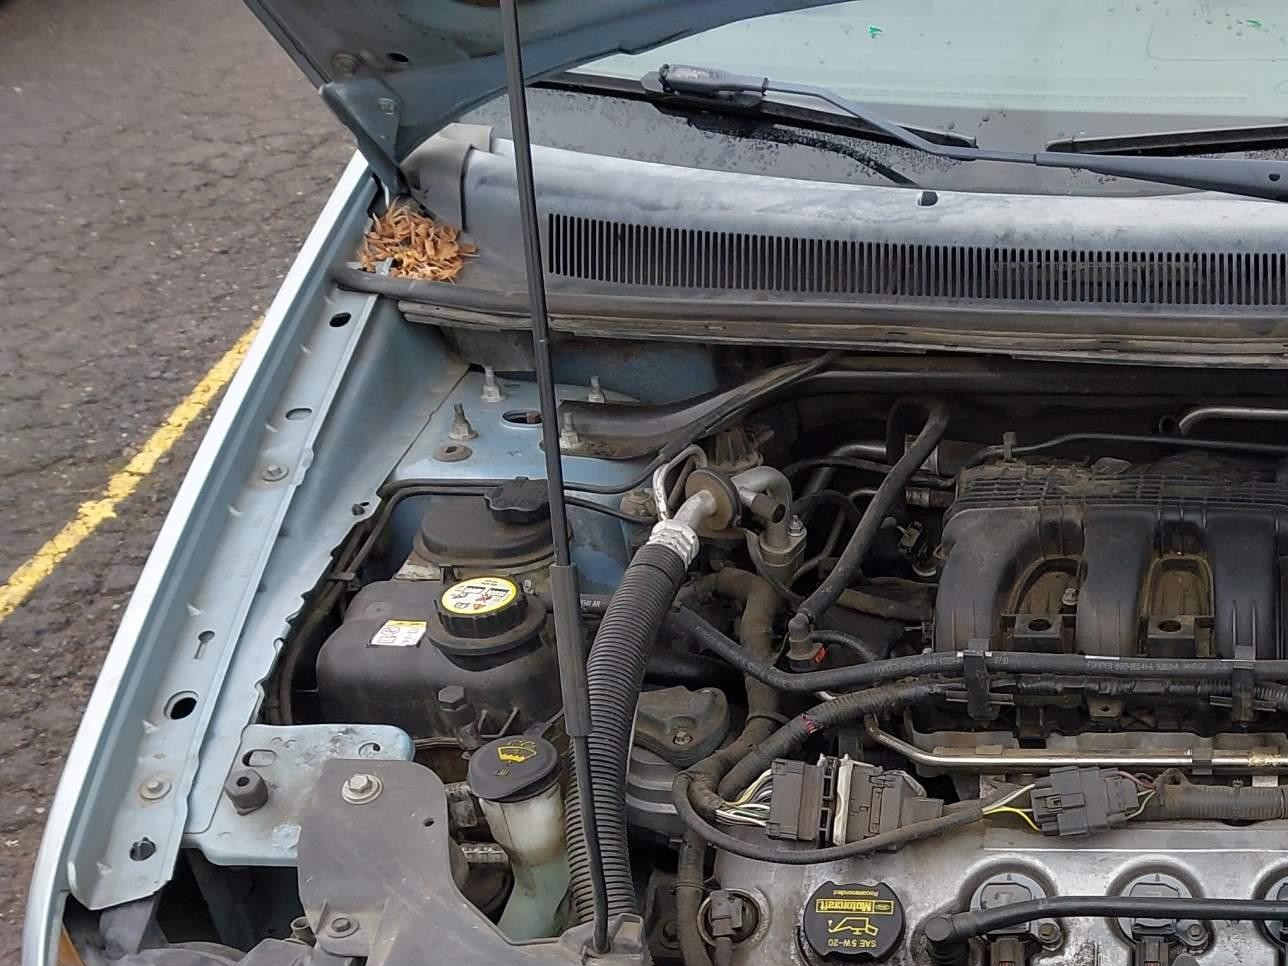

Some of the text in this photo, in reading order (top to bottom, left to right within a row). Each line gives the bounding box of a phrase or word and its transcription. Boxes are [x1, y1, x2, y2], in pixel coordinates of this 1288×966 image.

[832, 889, 879, 897] Recommended
[820, 900, 872, 912] Motorcraft
[827, 938, 877, 948] SAE 5W-20
